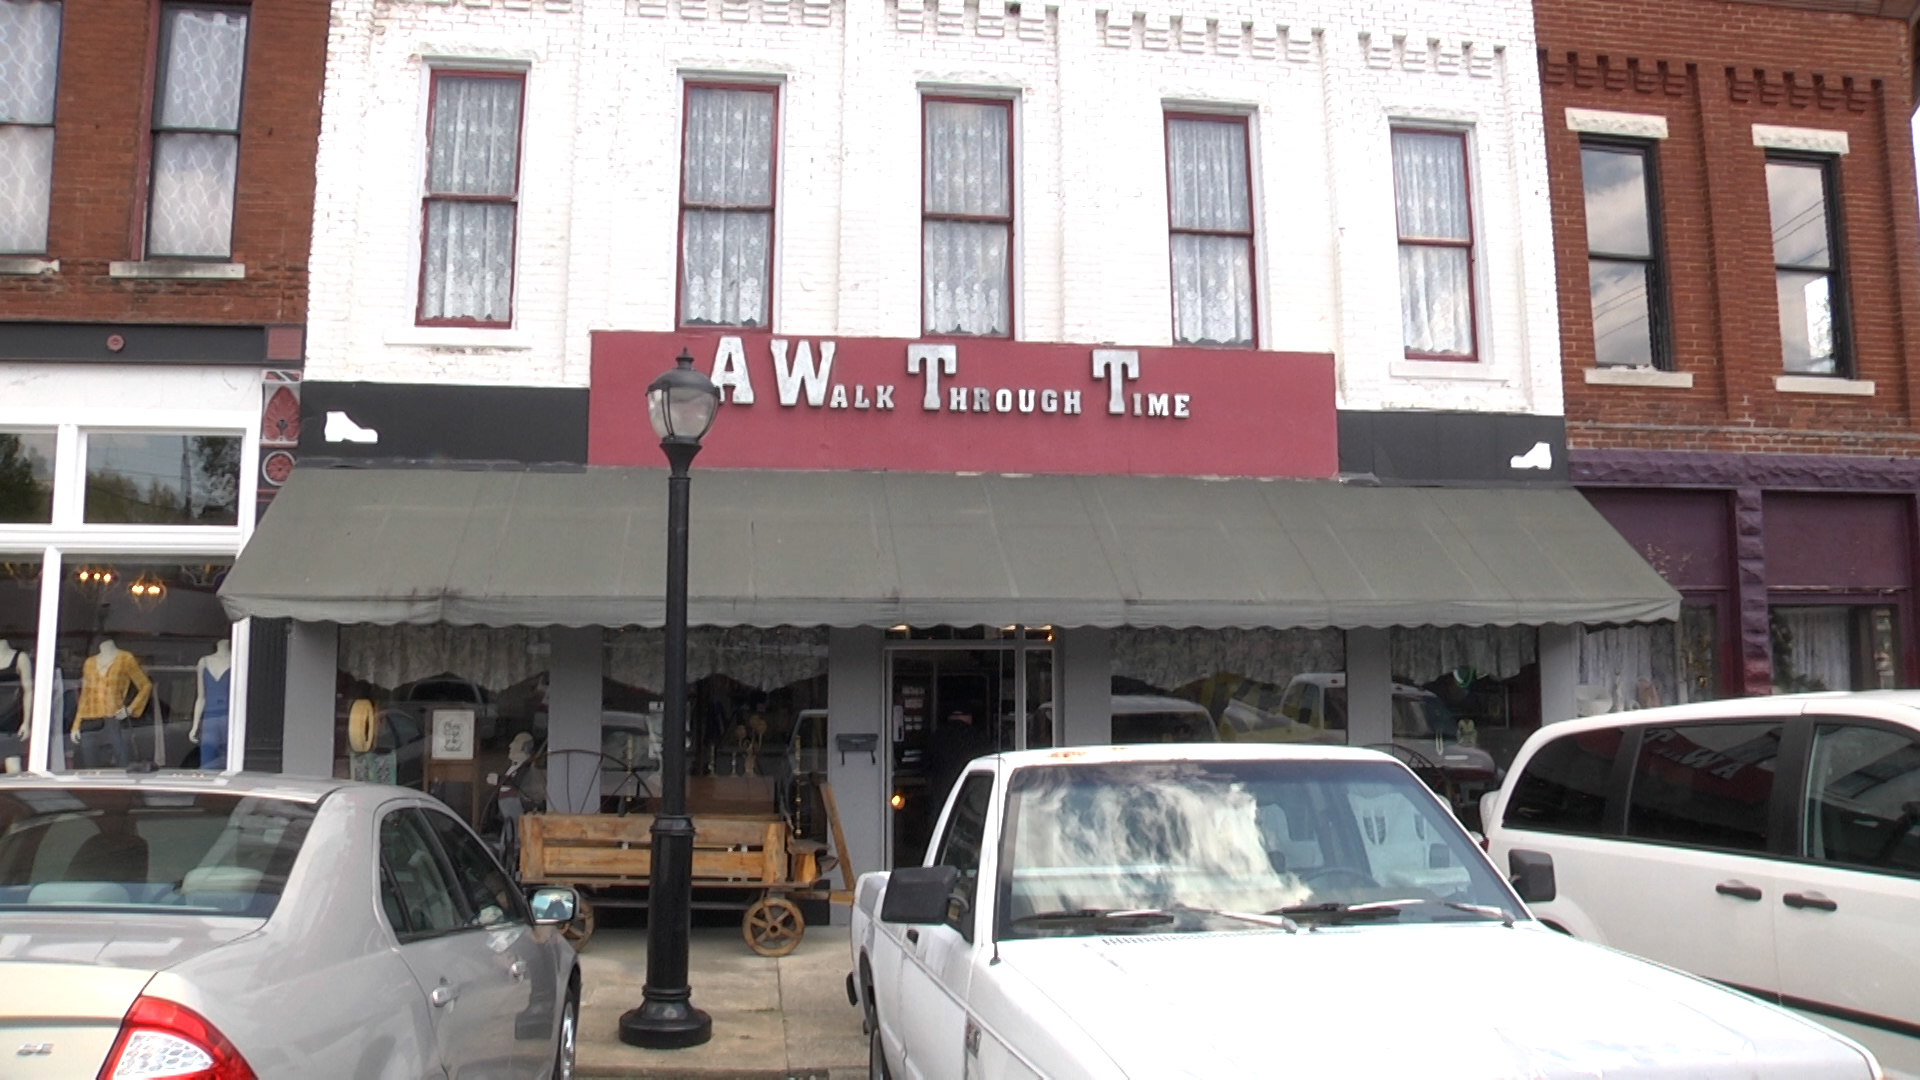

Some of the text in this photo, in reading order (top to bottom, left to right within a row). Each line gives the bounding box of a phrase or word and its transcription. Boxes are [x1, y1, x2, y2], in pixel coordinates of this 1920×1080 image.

[710, 335, 1190, 418] A WALK THROUGH TIME
